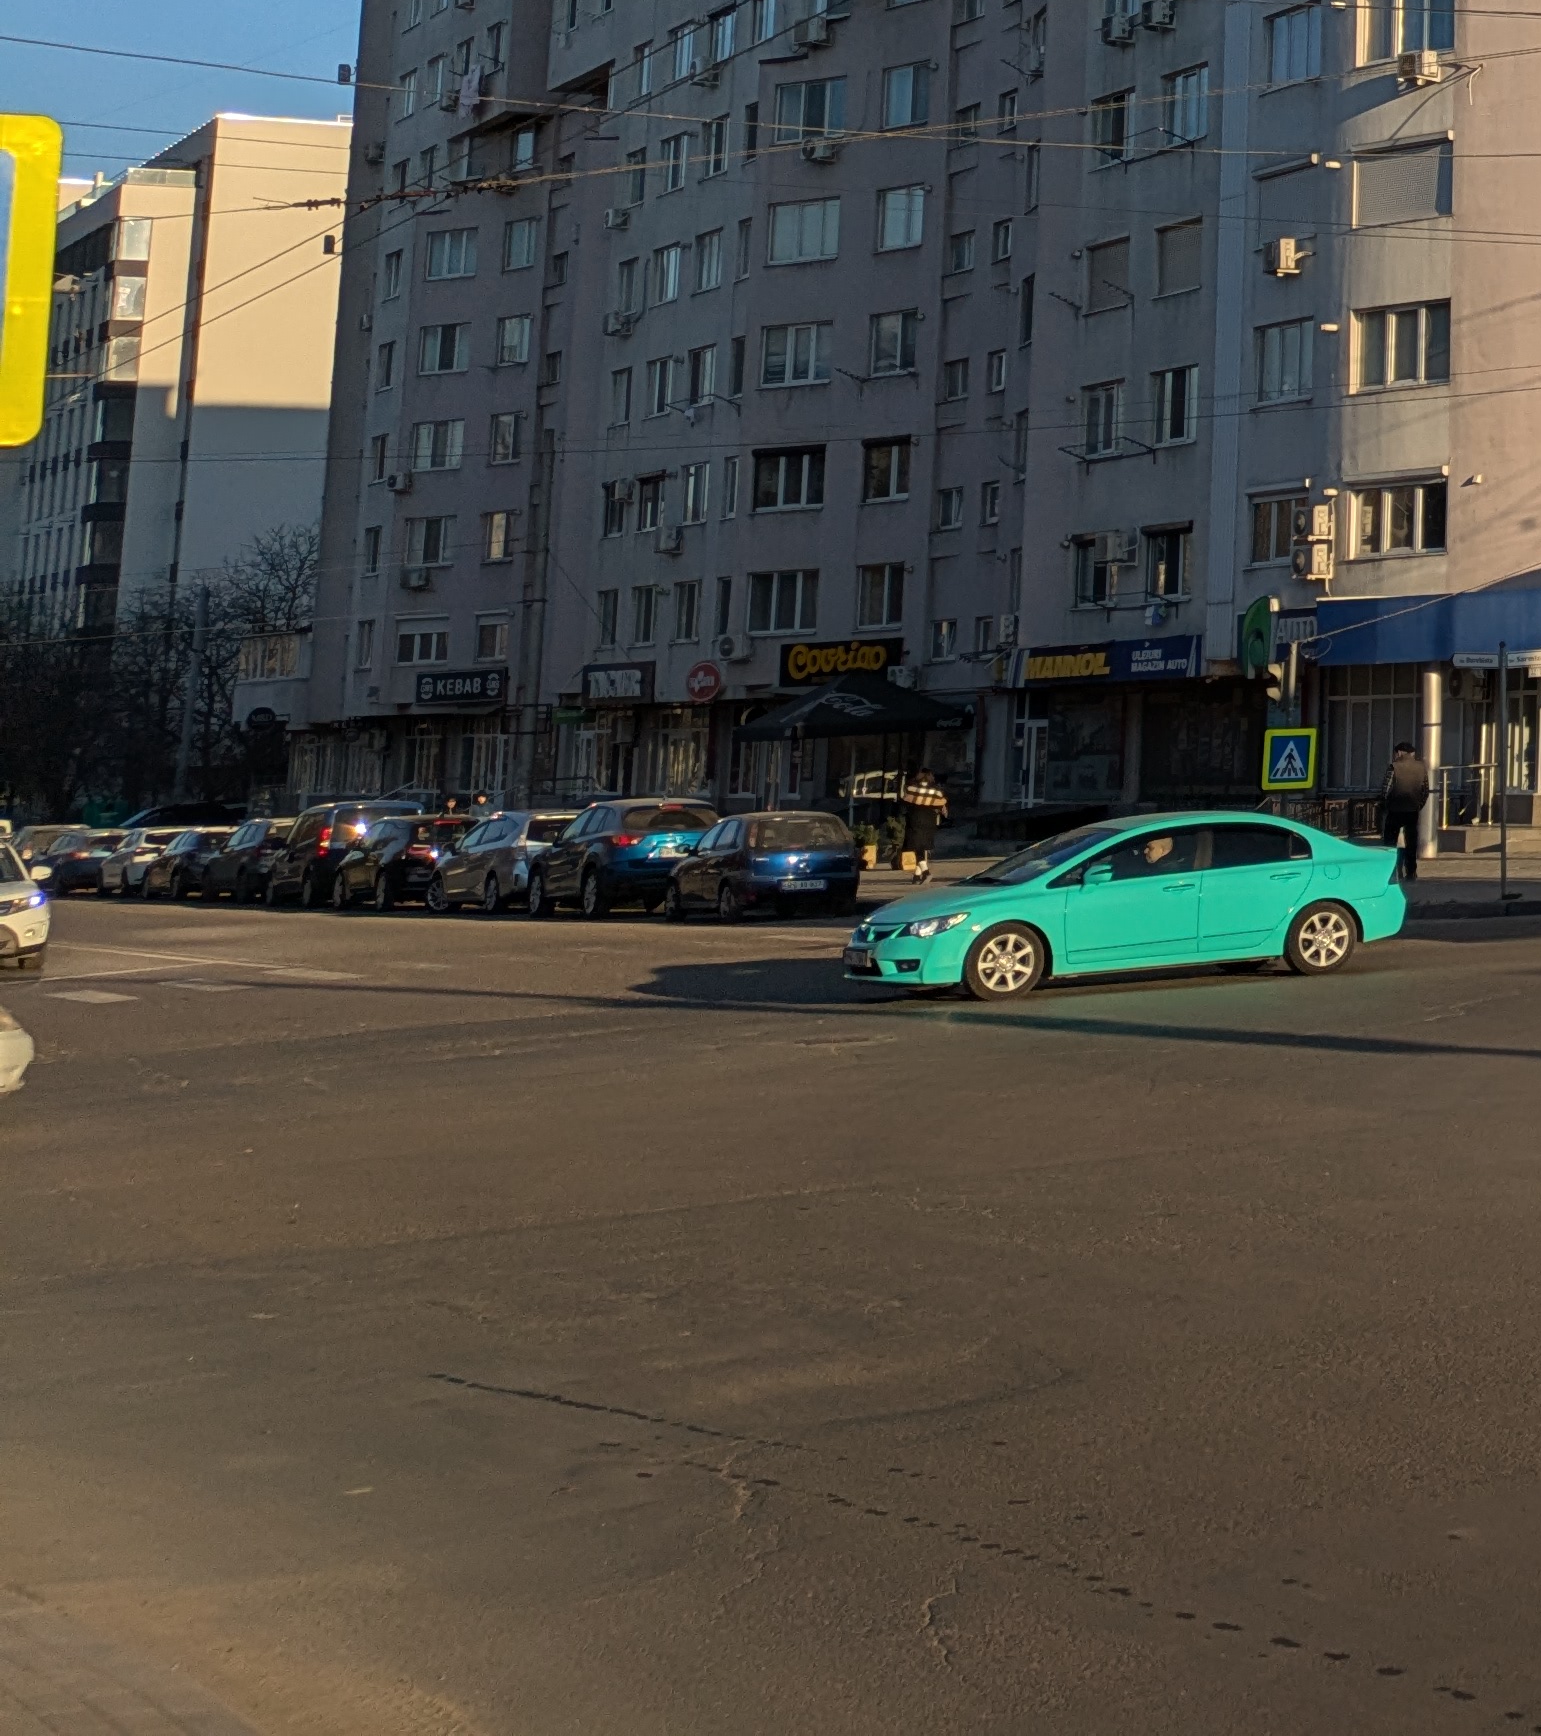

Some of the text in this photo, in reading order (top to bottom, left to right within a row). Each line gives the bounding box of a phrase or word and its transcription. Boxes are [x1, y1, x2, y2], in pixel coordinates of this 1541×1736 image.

[1025, 652, 1111, 680] MANNOL
[1131, 658, 1187, 673] MAGAZIN AUTO
[436, 677, 482, 696] KEBAB
